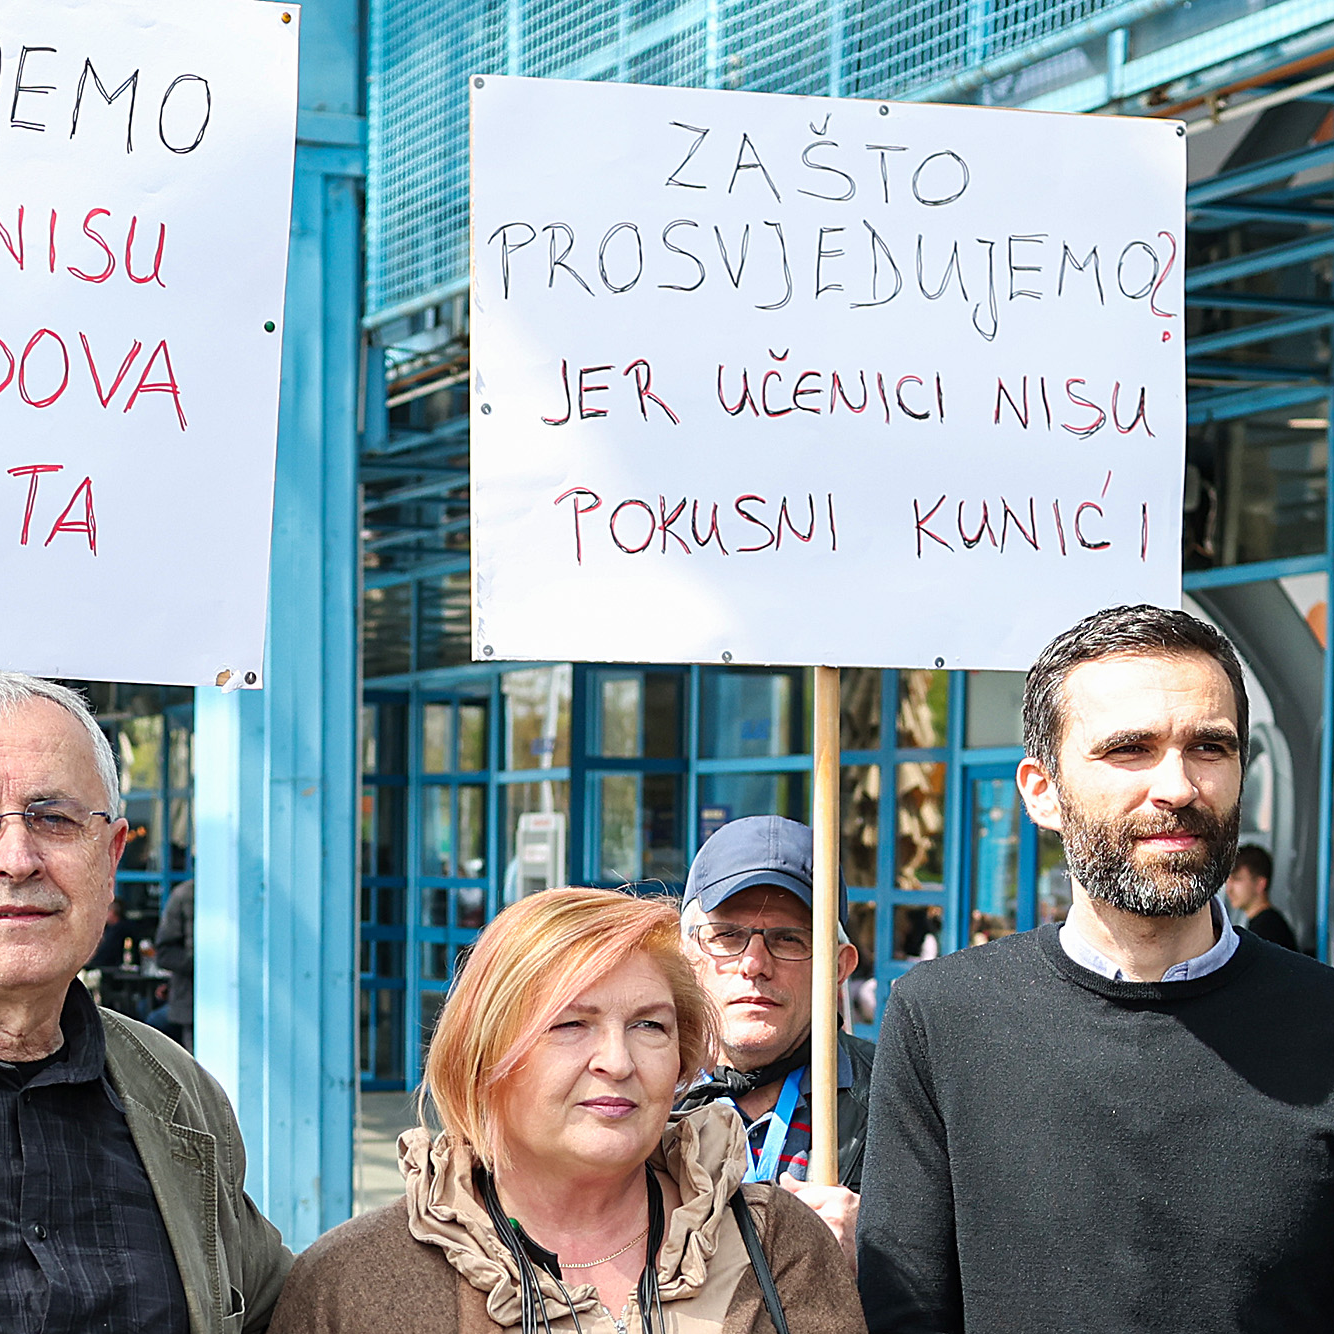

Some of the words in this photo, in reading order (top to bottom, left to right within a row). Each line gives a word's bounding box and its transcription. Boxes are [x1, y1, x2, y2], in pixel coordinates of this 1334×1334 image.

[665, 113, 970, 207] ZAŠTO
[487, 219, 1177, 343] PROSVJEDUJEMO?
[540, 358, 680, 427] JER
[717, 348, 945, 424] UČENICI
[994, 375, 1156, 441] NISU
[553, 486, 837, 566] POKUSNI
[913, 470, 1148, 562] KUNIĆI
